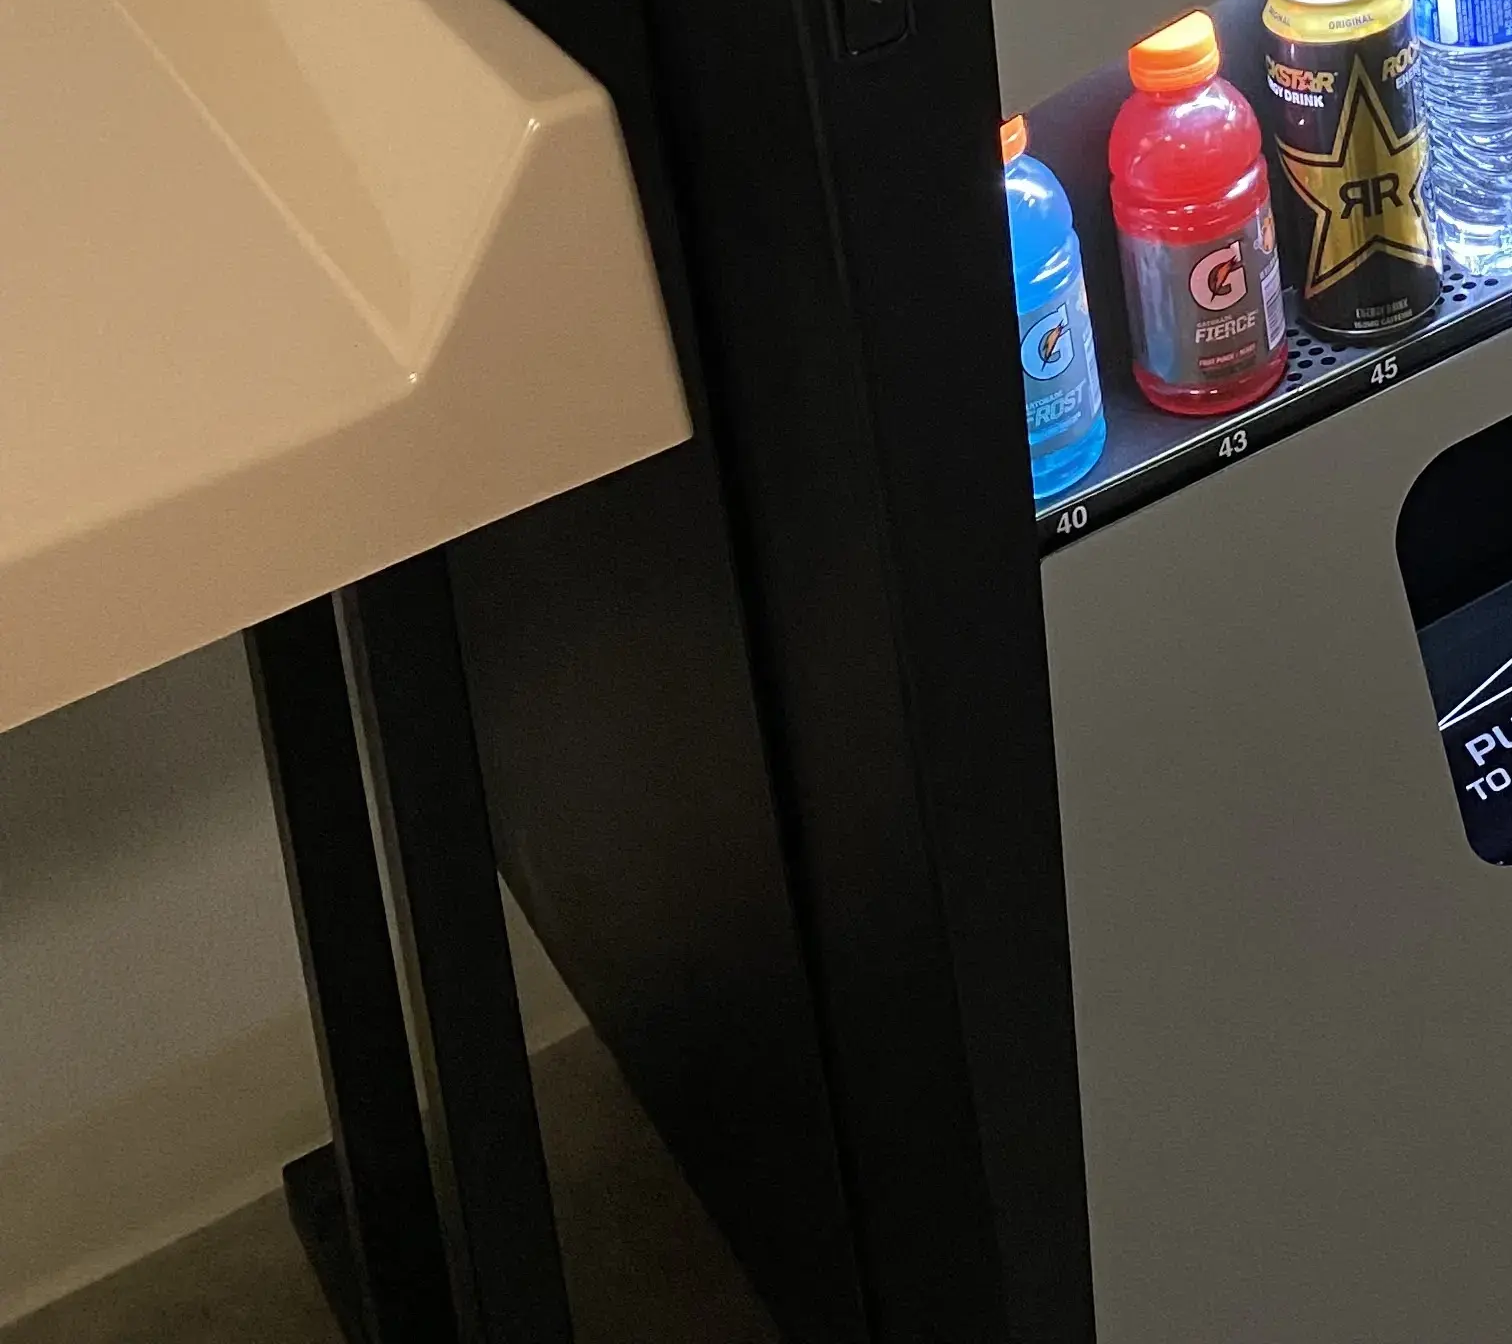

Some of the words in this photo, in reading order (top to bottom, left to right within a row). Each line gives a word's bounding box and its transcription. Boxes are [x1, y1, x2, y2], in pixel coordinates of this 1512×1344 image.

[1327, 14, 1375, 30] ORIGINAL
[1285, 88, 1325, 108] DRINK
[1189, 240, 1248, 311] G
[1194, 308, 1260, 344] FIERCE
[1020, 302, 1075, 381] G
[1370, 355, 1398, 384] 45
[1218, 429, 1248, 459] 43
[1056, 505, 1088, 535] 40
[1465, 766, 1512, 803] TO
